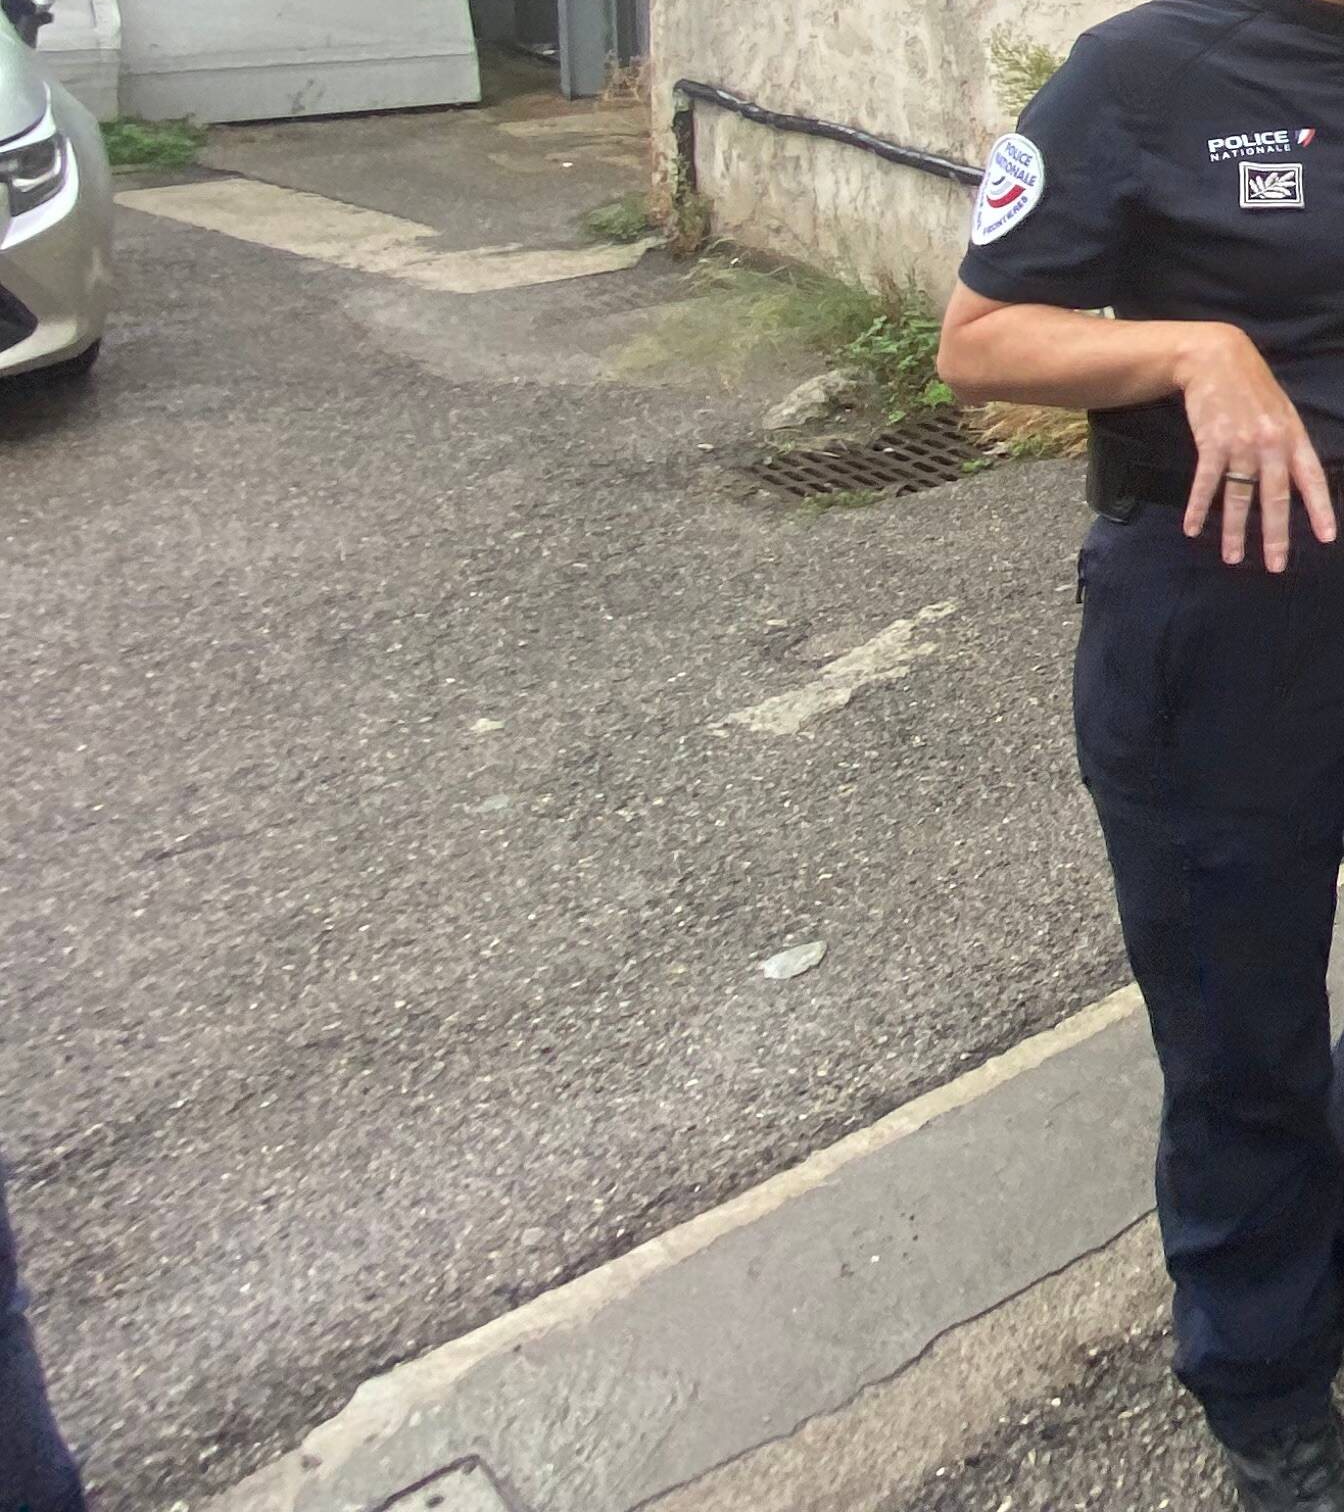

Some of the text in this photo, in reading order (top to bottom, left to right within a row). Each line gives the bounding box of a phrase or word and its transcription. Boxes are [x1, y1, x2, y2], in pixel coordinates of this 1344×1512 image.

[1208, 130, 1289, 153] POLICE
[1210, 144, 1291, 162] NATIONALE
[1006, 142, 1032, 167] POLICE
